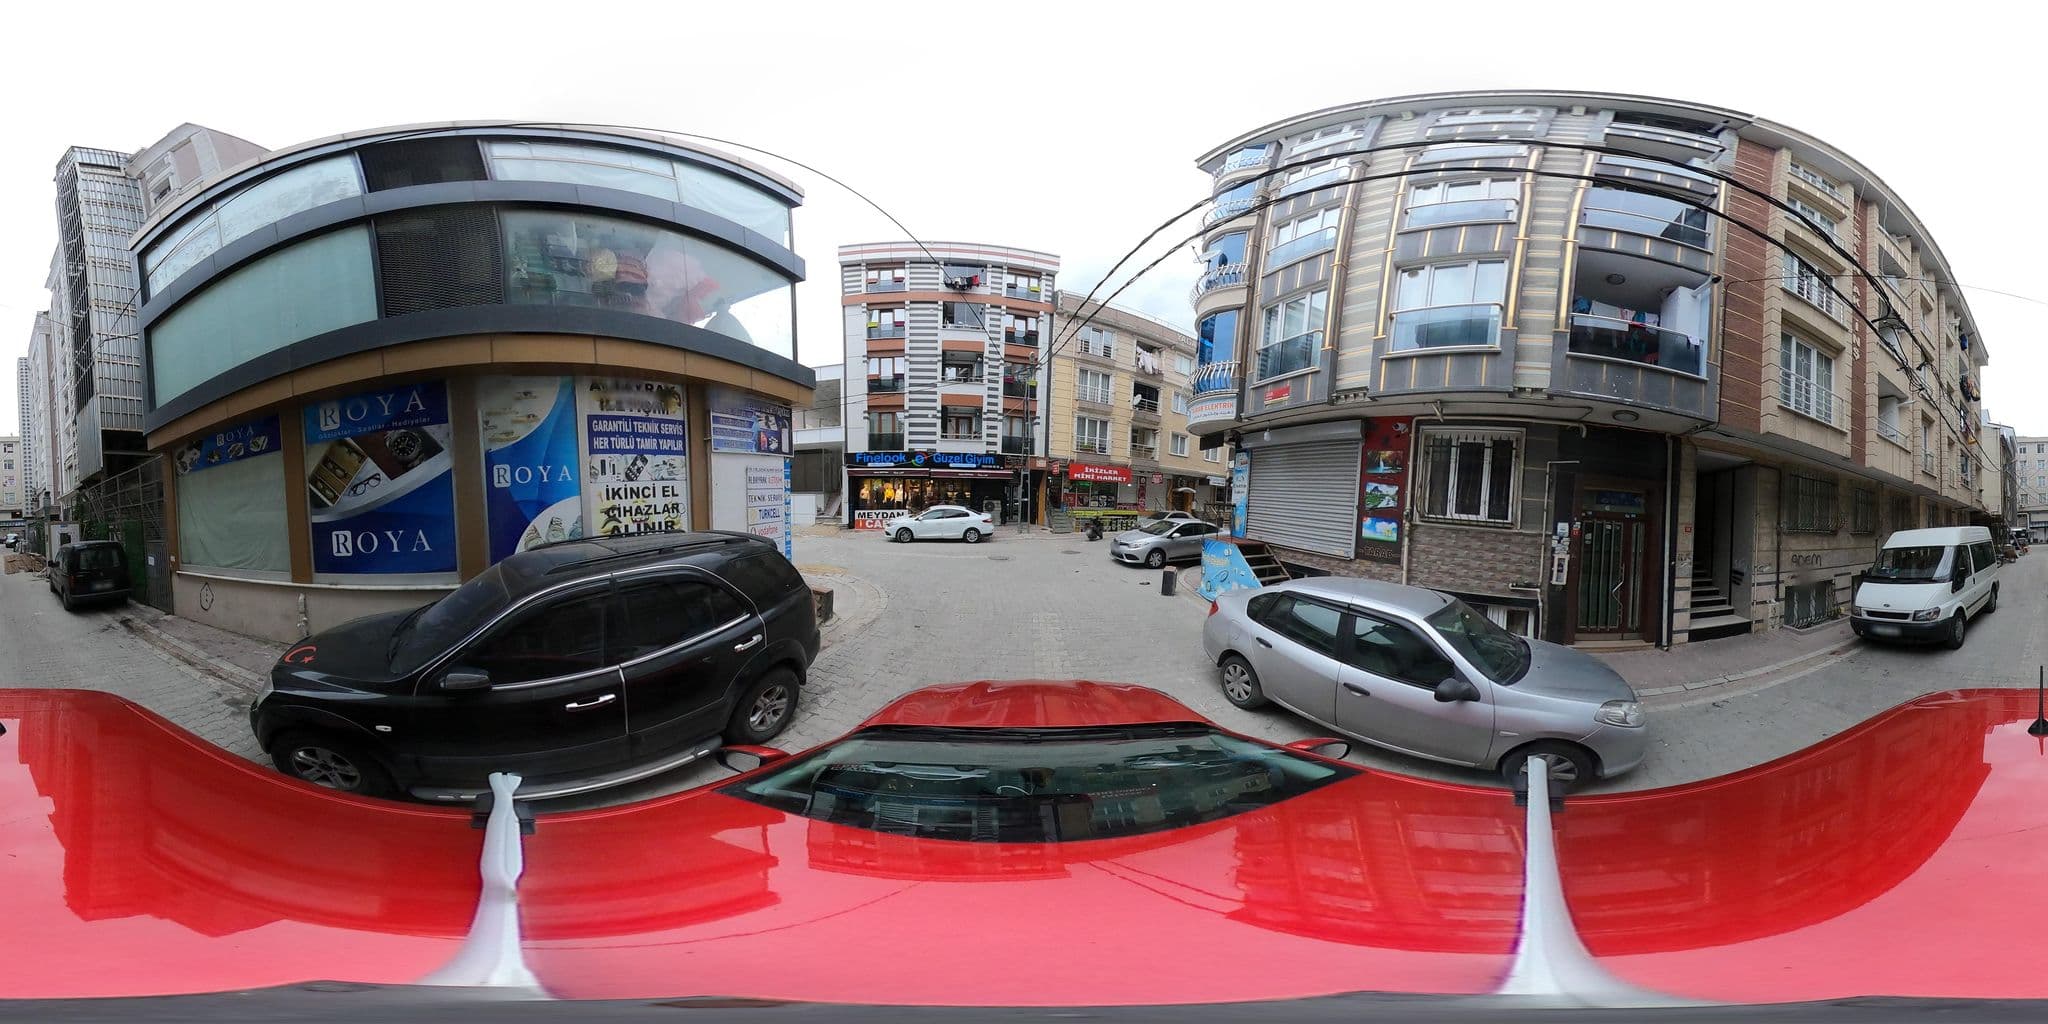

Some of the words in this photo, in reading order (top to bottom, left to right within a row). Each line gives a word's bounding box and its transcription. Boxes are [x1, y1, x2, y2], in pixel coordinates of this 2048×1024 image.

[321, 389, 427, 431] ROYA
[217, 426, 255, 446] ROYA
[592, 418, 632, 432] GARANTİLİ
[633, 419, 660, 434] TEKNİK
[660, 421, 684, 436] SERVİS
[593, 437, 609, 449] HER
[610, 436, 635, 449] TÜRLÜ
[636, 436, 658, 450] TAMİR
[659, 438, 684, 451] YAPILIR
[855, 452, 907, 463] Finelook
[933, 453, 964, 464] Güzel
[965, 453, 996, 465] Giyim
[493, 464, 573, 488] ROYA
[1097, 475, 1128, 483] MARKET
[605, 483, 657, 501] İKİNCİ
[661, 485, 680, 498] EL
[857, 511, 904, 519] MEYDAN
[332, 529, 433, 557] ROYA
